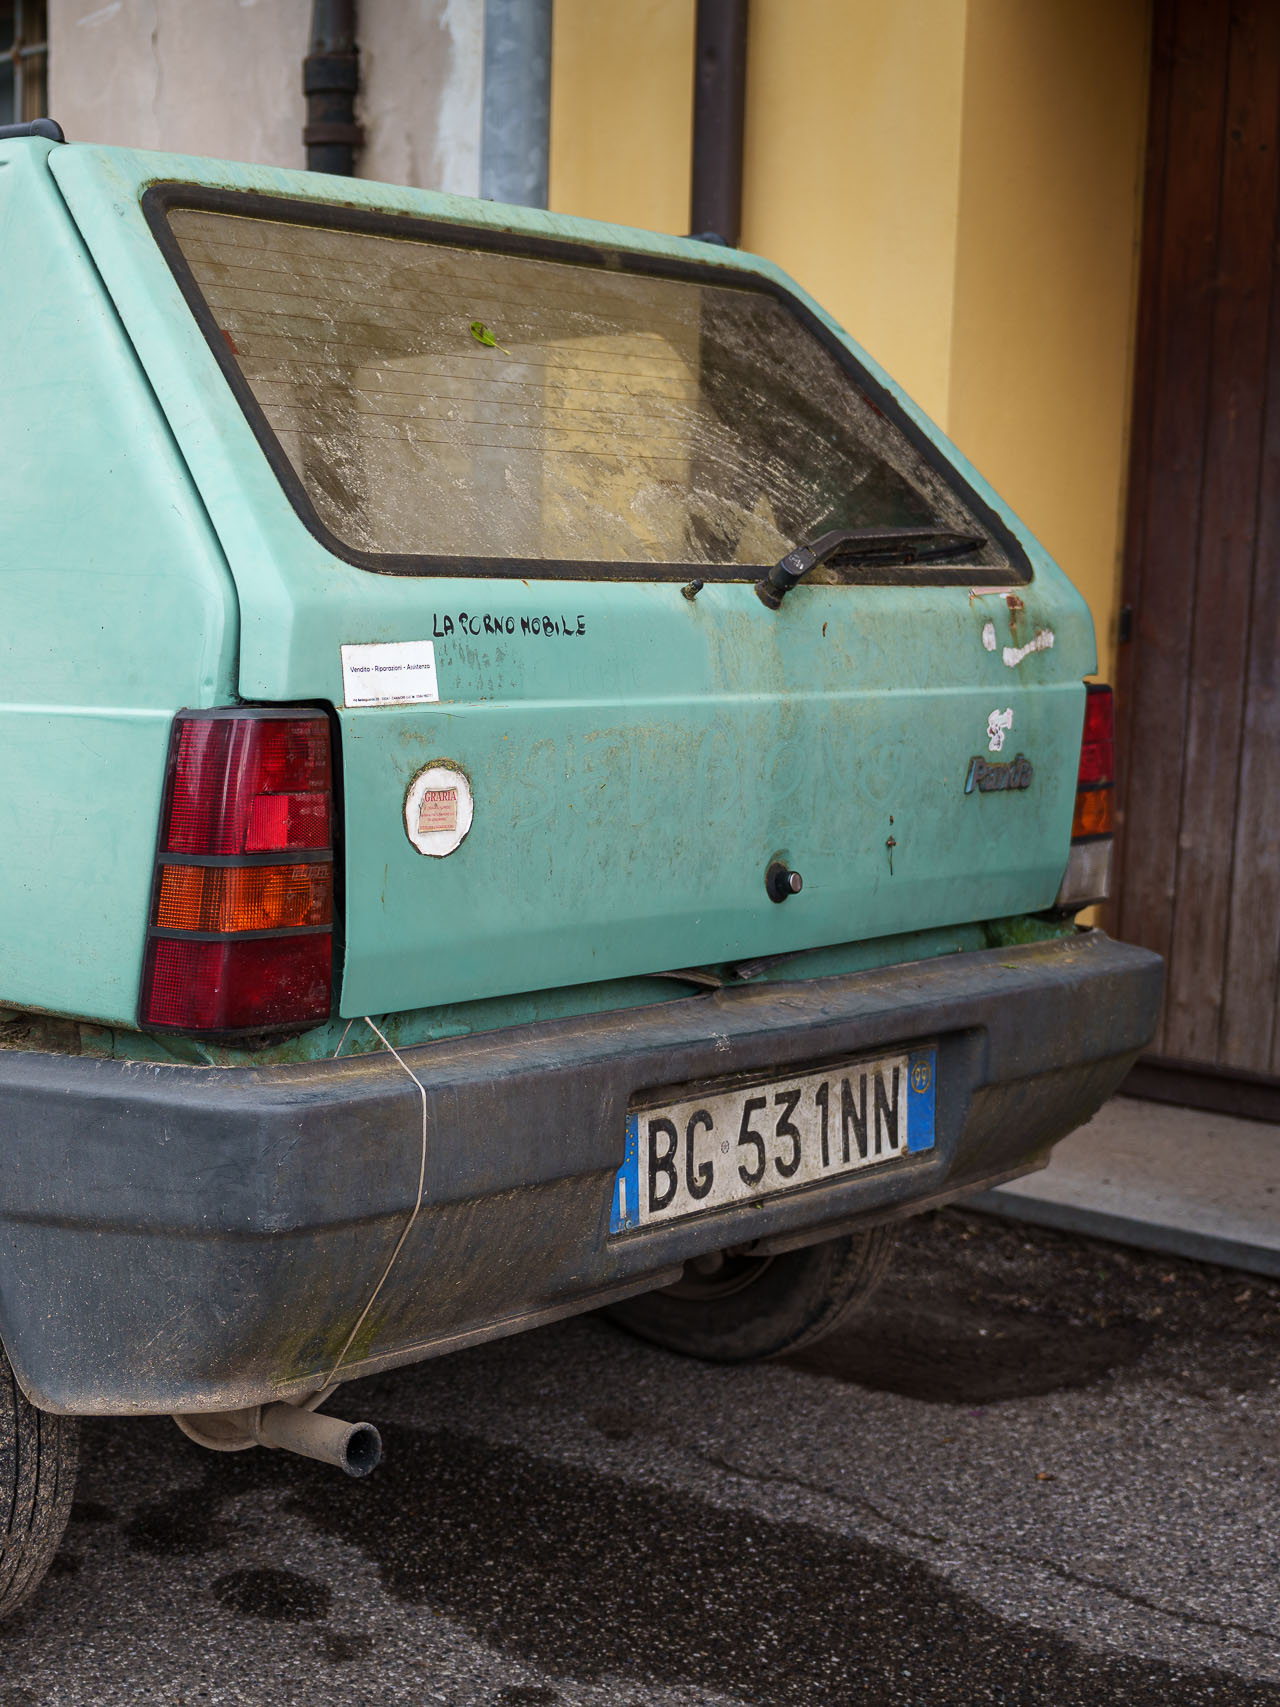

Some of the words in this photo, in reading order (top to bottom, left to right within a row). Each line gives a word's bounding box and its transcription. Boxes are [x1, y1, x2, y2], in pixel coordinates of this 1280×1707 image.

[432, 613, 454, 637] LA
[459, 612, 515, 636] PORNO
[407, 663, 431, 671] Assistenza
[619, 1177, 627, 1219] I
[648, 1109, 714, 1214] BG
[737, 1066, 900, 1188] 531NN
